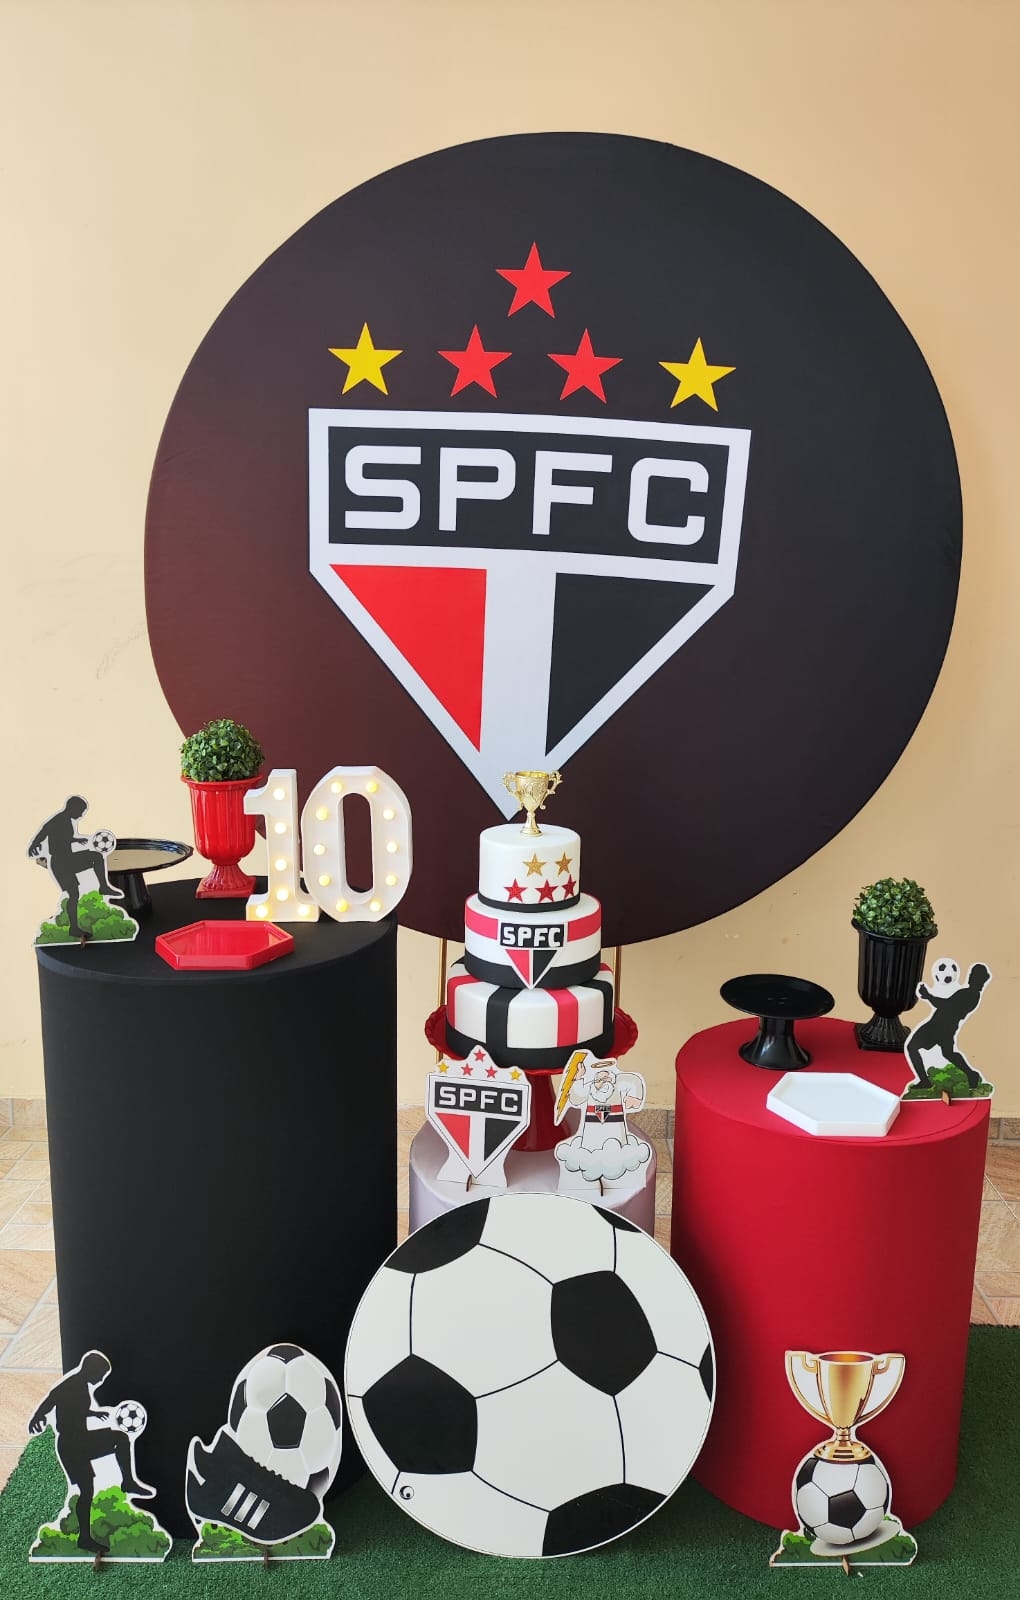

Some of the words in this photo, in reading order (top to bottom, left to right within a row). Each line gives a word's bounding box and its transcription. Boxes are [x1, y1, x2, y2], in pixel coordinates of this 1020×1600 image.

[344, 445, 710, 546] SPFC
[243, 766, 413, 922] 10
[502, 926, 561, 947] SPFC
[438, 1086, 519, 1113] SPFC
